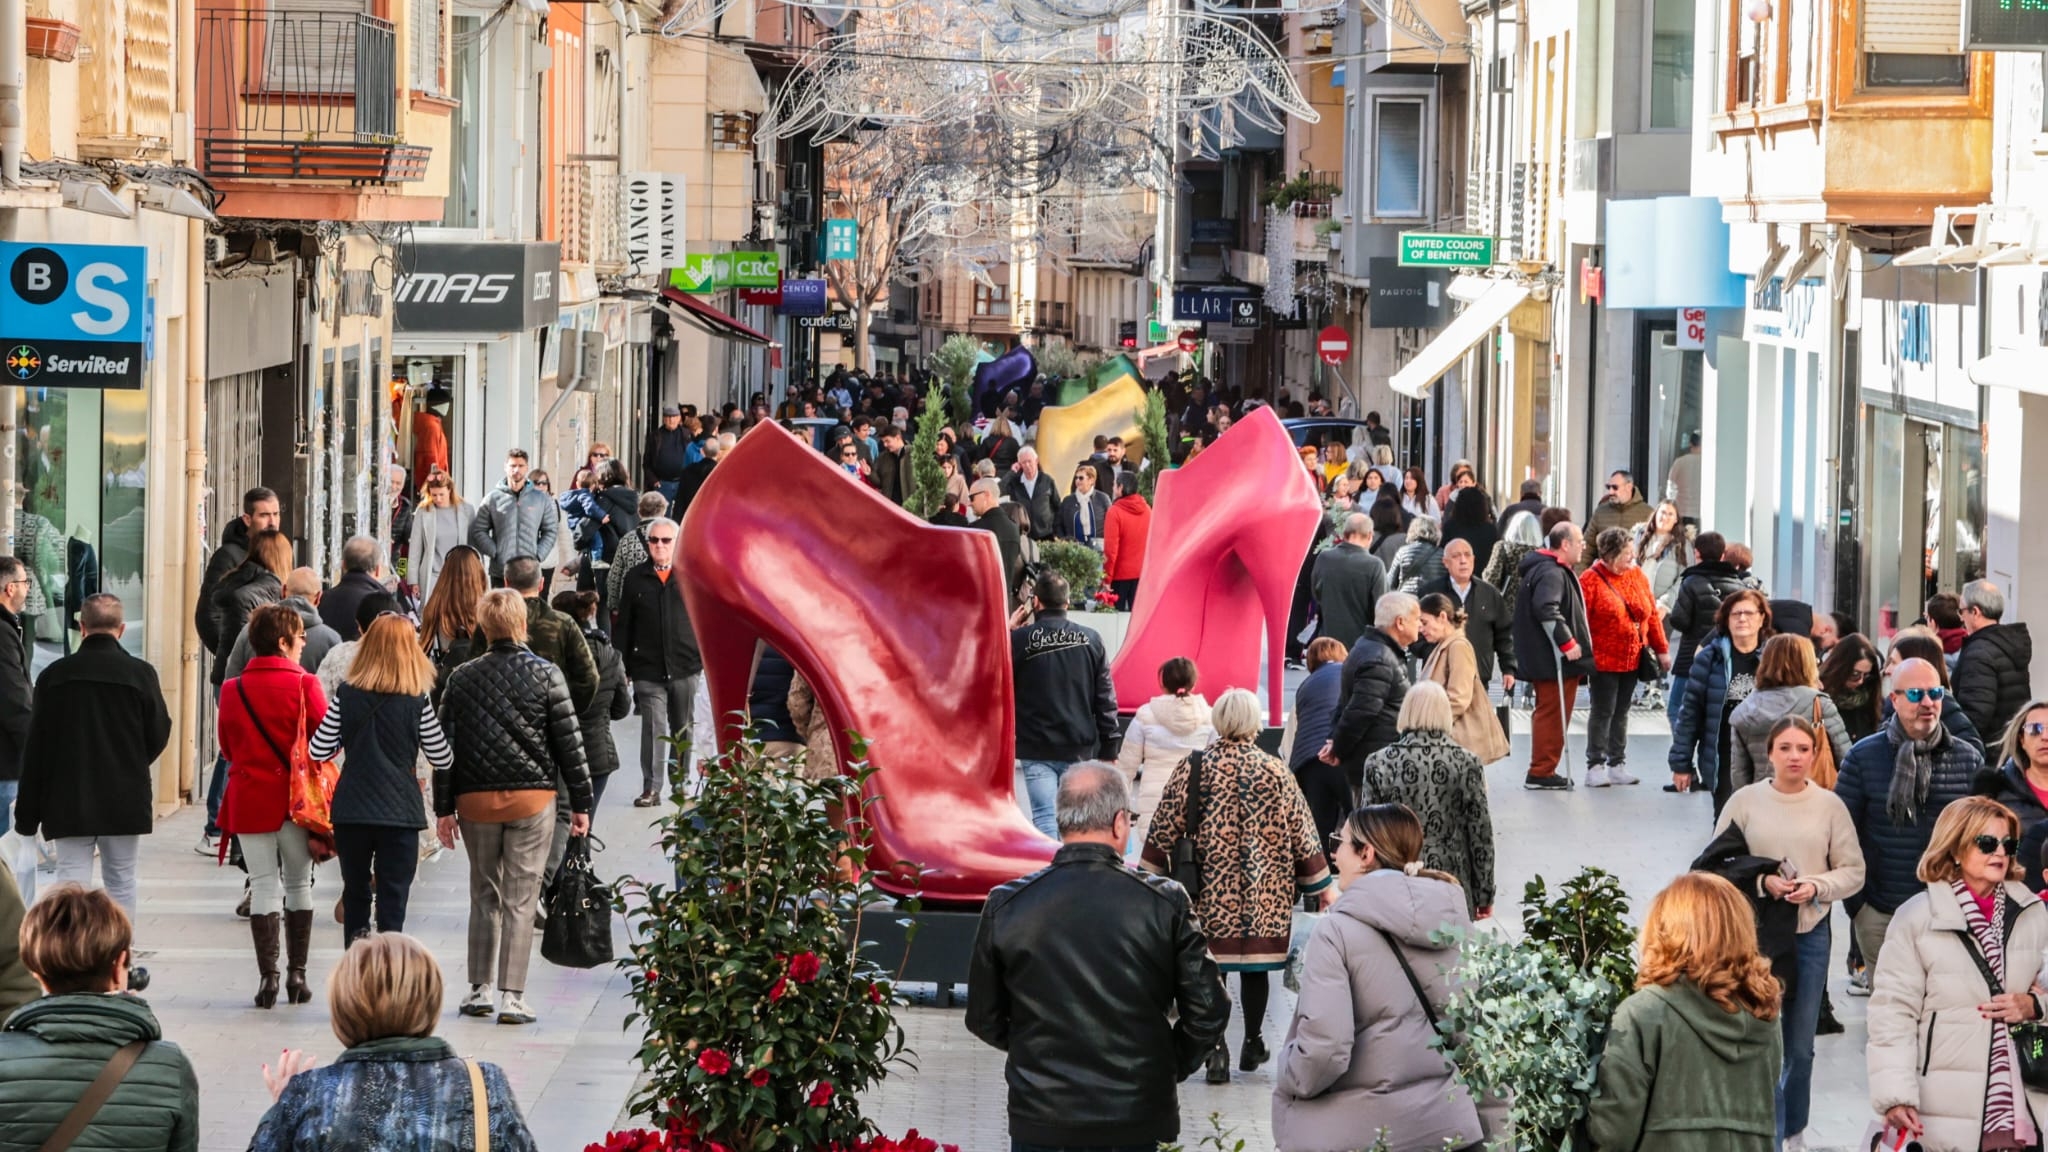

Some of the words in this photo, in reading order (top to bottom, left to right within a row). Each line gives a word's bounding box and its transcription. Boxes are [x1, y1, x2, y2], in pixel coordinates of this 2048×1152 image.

[630, 180, 649, 265] MANGO
[1407, 239, 1444, 249] UNITED
[1446, 241, 1485, 250] COLORS
[1411, 250, 1424, 260] OF
[737, 261, 777, 277] CRC
[782, 285, 818, 293] CENTRO
[27, 262, 52, 291] B
[71, 262, 130, 335] S
[1181, 296, 1221, 315] LLAR
[47, 355, 130, 374] ServiRed
